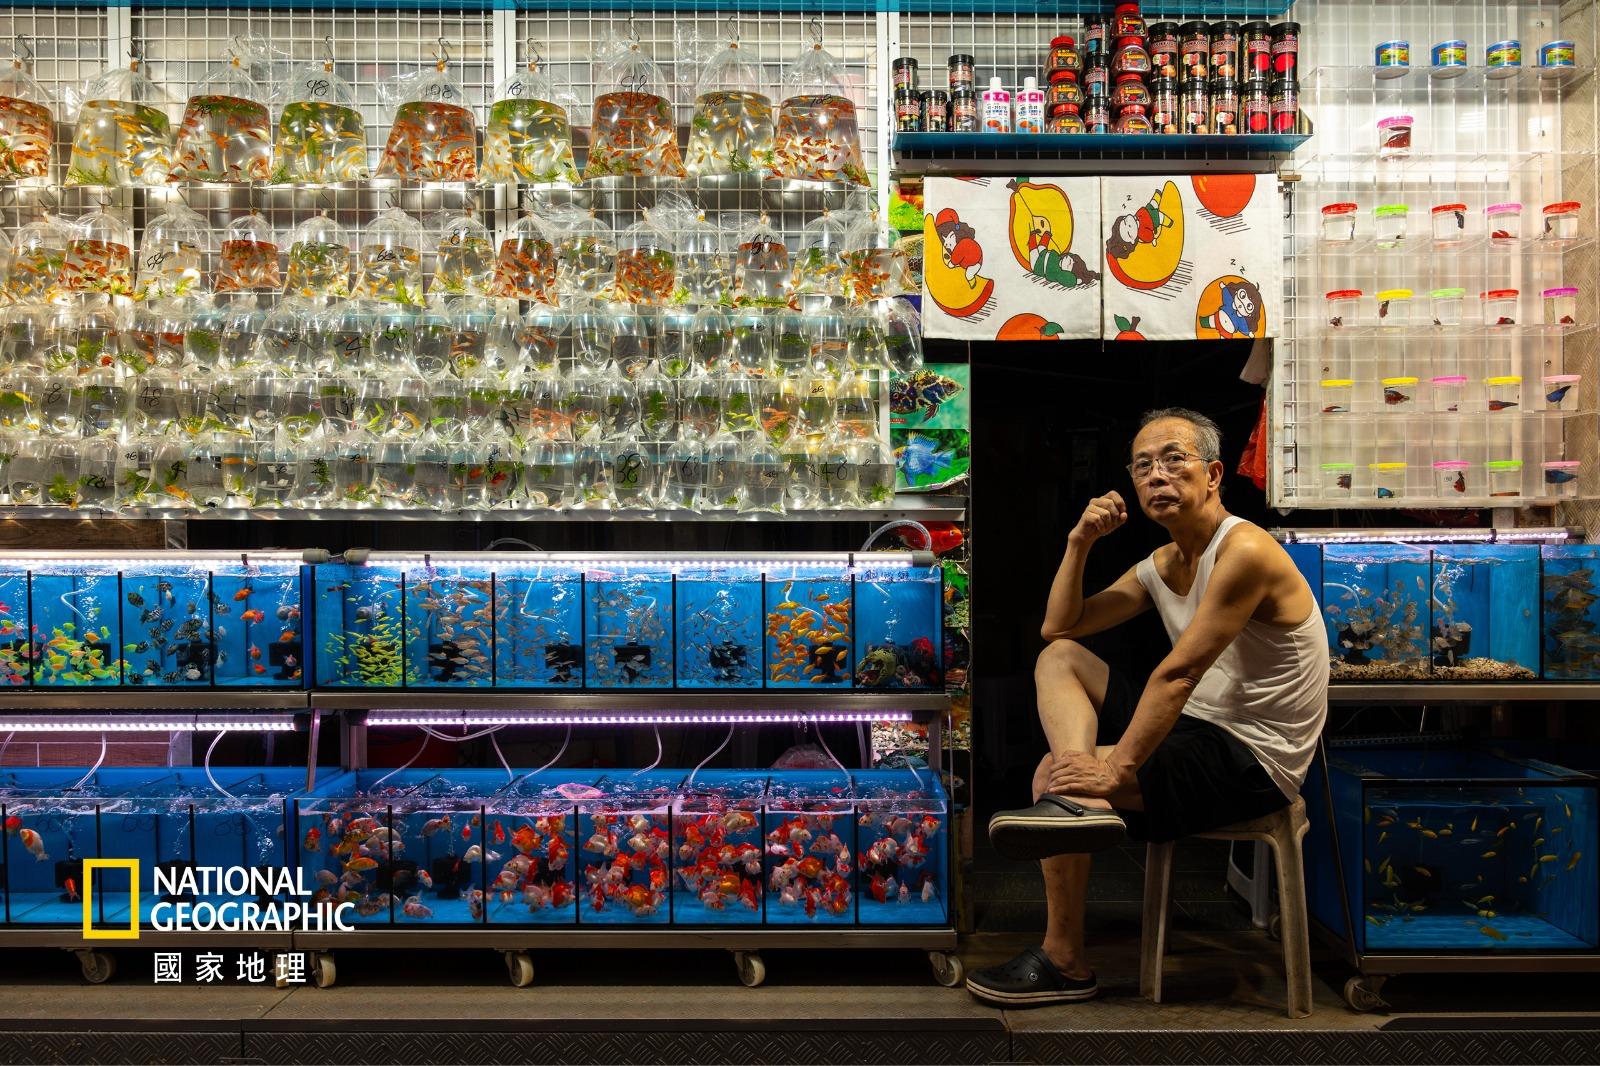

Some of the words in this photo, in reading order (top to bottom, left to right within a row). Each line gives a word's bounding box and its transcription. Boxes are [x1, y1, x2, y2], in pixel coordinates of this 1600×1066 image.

[306, 79, 330, 96] 98
[620, 74, 650, 107] 98
[141, 386, 161, 407] 48
